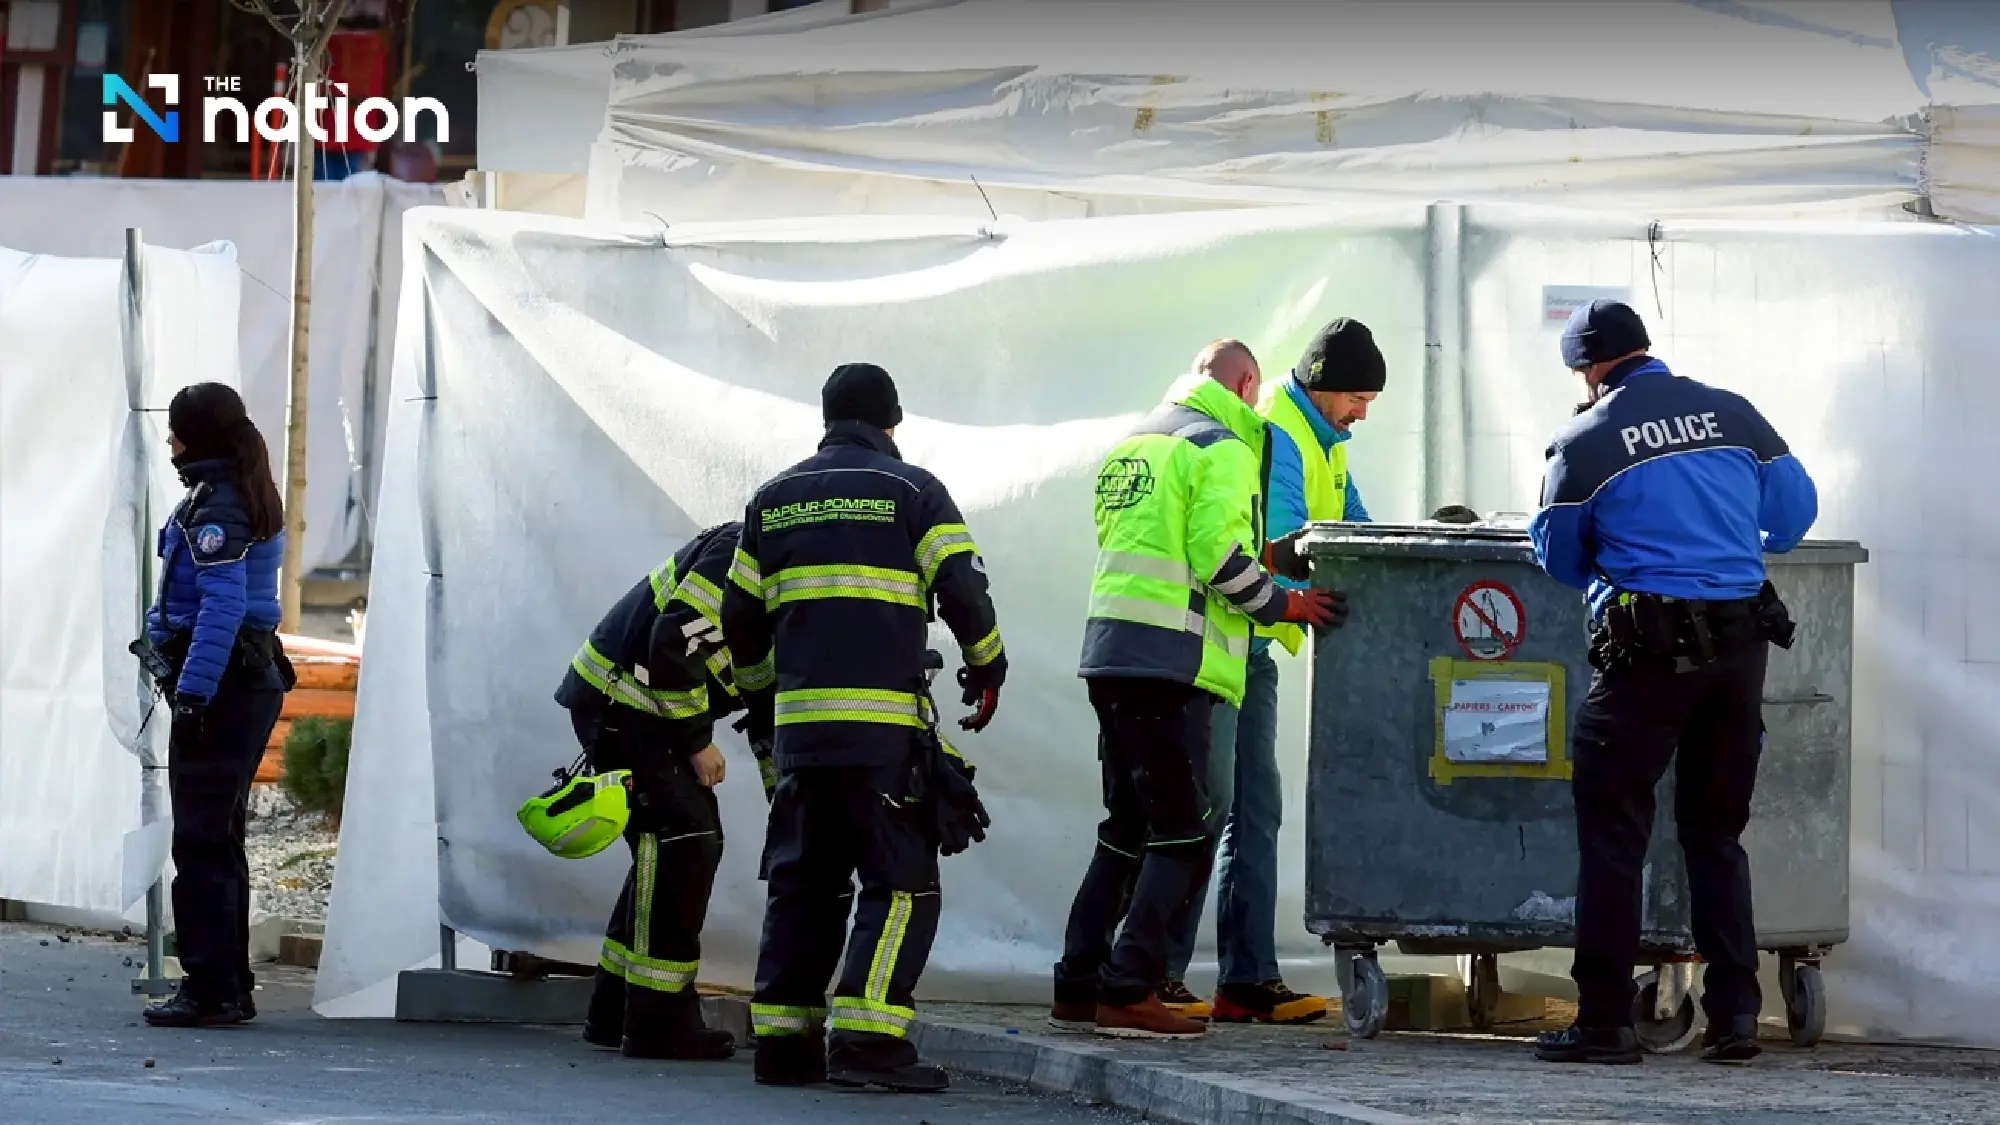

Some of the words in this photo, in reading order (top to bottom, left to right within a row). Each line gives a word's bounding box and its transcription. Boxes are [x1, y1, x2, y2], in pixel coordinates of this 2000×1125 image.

[1620, 411, 1723, 457] POLICE
[762, 498, 895, 520] SAPEUR-POMPIER
[1454, 702, 1490, 712] PAPIERS
